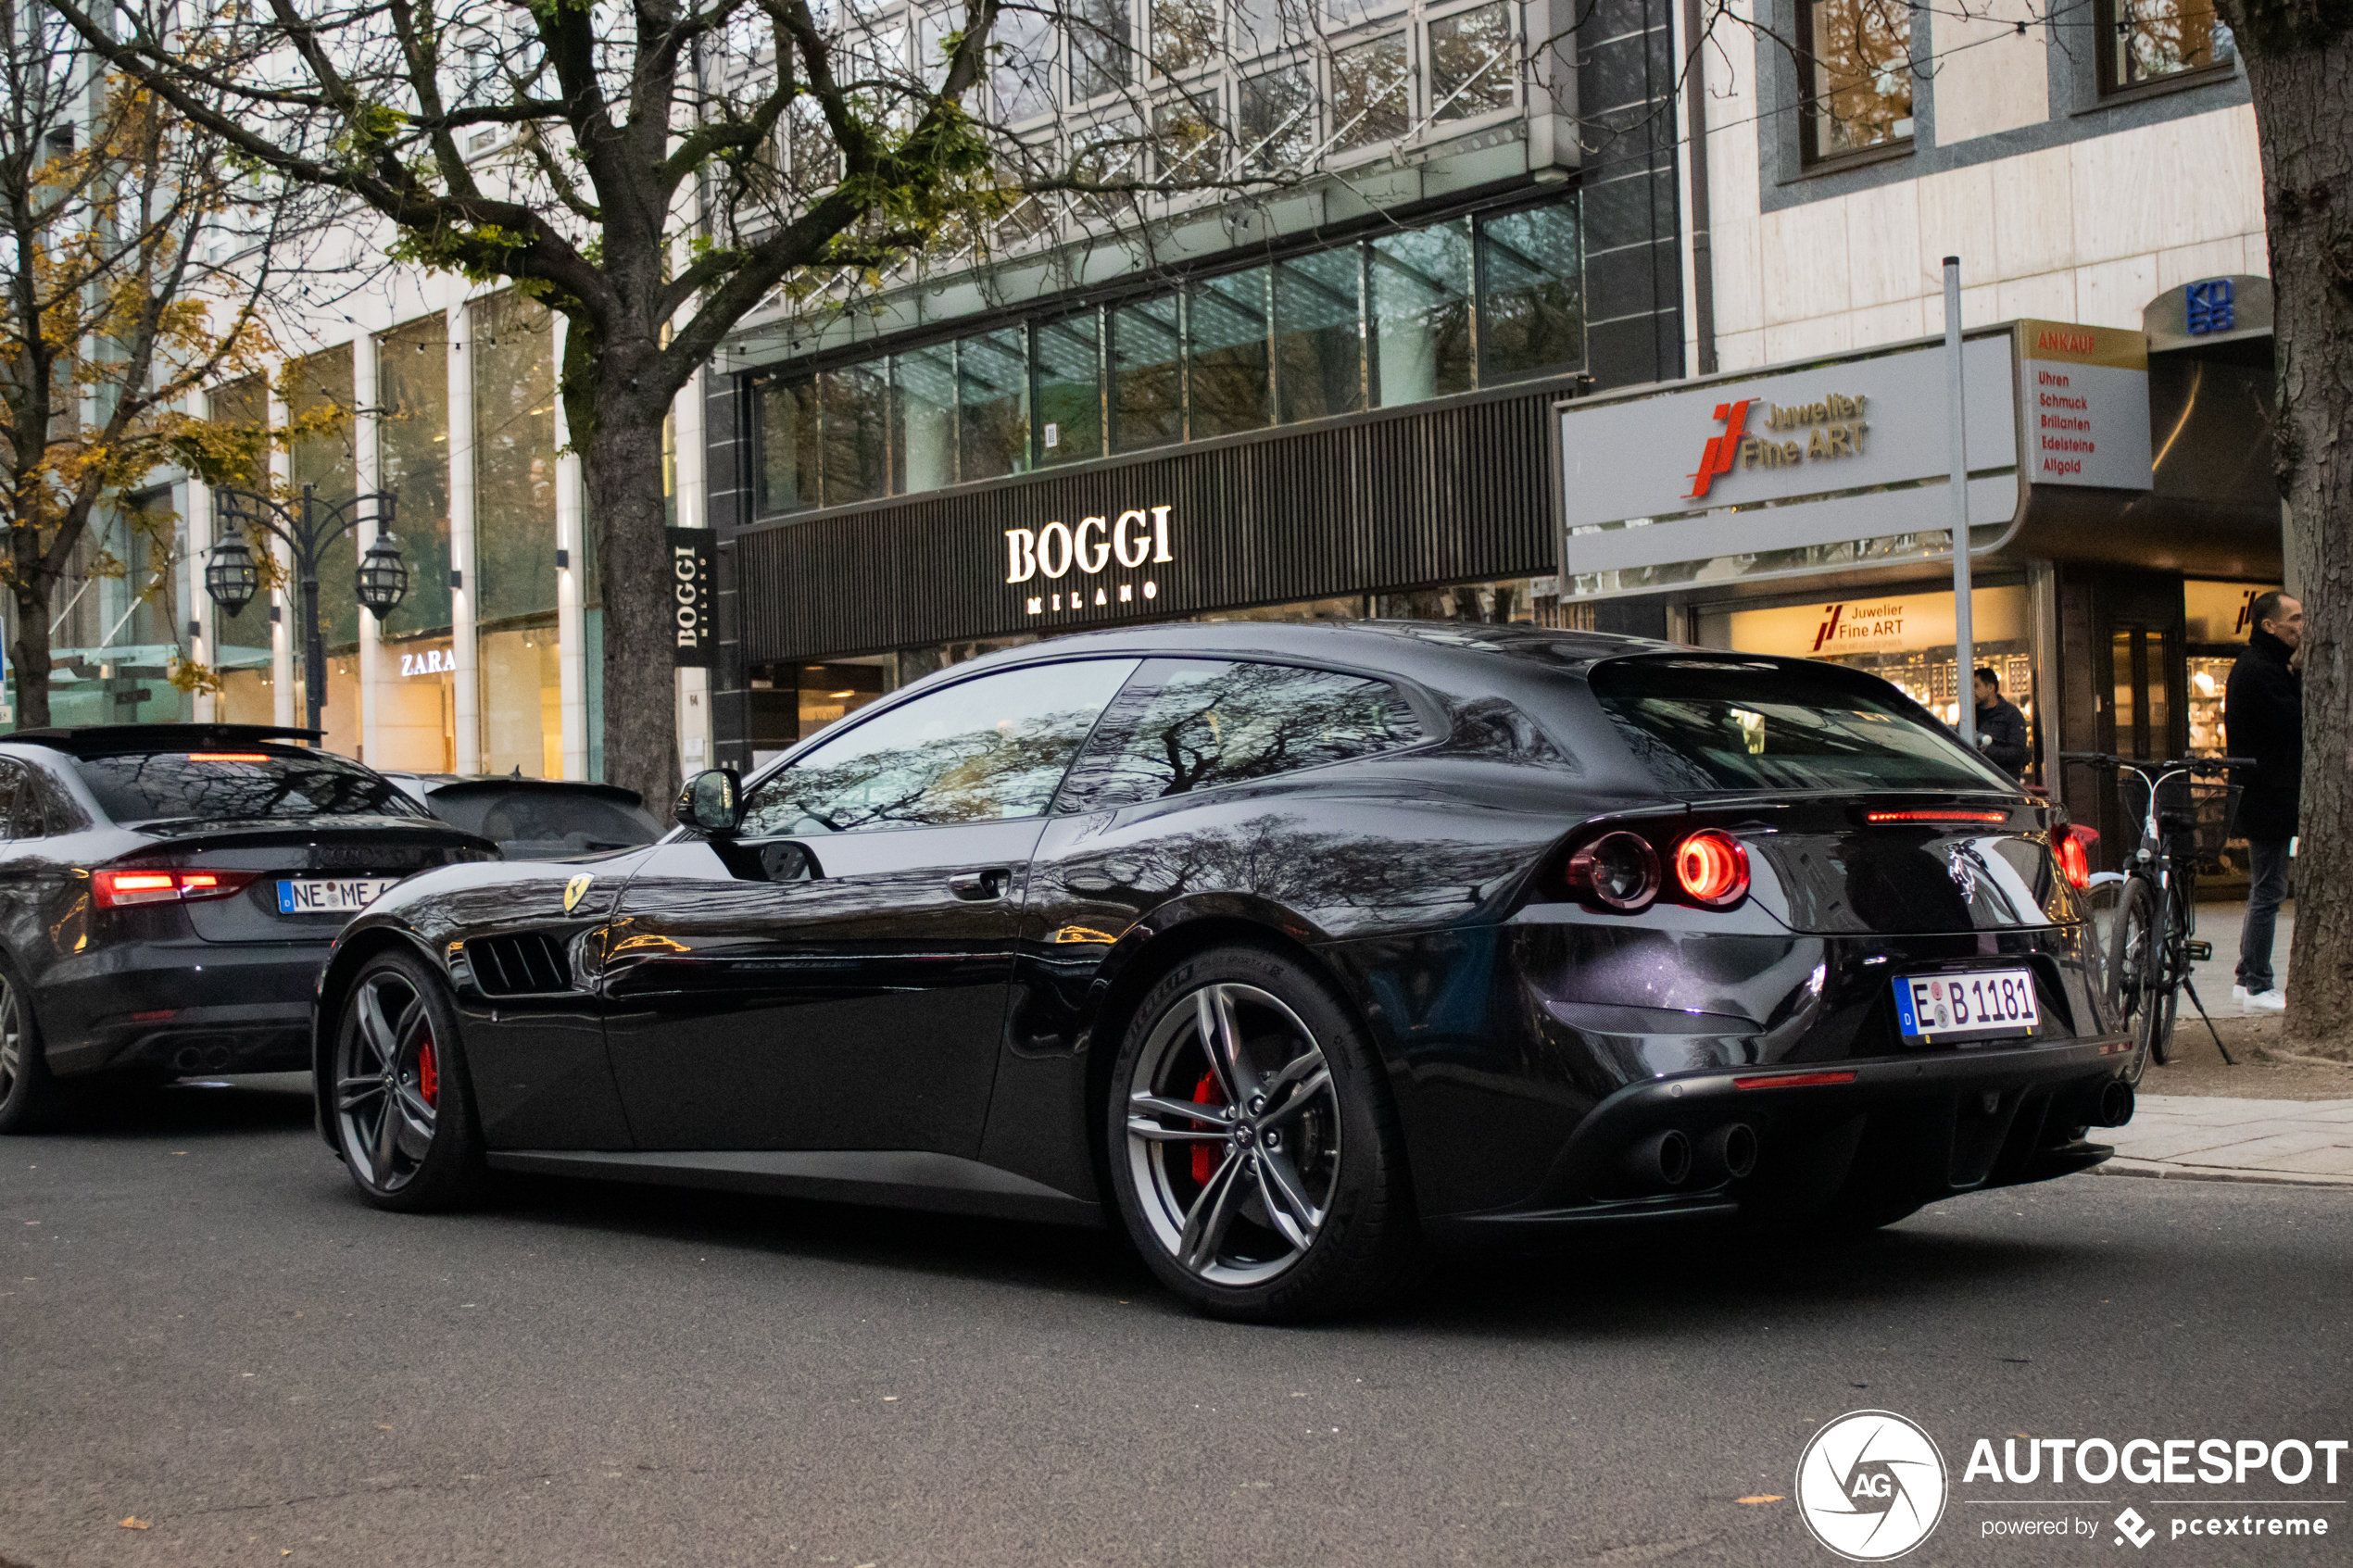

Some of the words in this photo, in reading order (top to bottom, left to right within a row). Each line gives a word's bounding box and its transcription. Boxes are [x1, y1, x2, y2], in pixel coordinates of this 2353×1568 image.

[2038, 331, 2095, 354] ANKAUF
[2038, 371, 2070, 387] Uhren
[1764, 393, 1866, 430] Juwelier
[2039, 393, 2088, 410] Schmuck
[2041, 414, 2091, 432] Brillanten
[1741, 436, 1800, 469] Fine
[1806, 420, 1868, 460] ART
[2041, 435, 2095, 453] Edelsteine
[2043, 458, 2082, 476] Altgold
[1005, 505, 1173, 583] BOGGI
[674, 546, 698, 648] BOGGI
[700, 558, 709, 637] MILANO
[1026, 581, 1157, 615] MILANO
[1851, 603, 1904, 620] Juwelier
[1839, 623, 1869, 639] Fine
[1873, 620, 1904, 636] ART
[400, 648, 457, 677] ZARA
[293, 884, 326, 908] NE
[340, 883, 370, 906] ME
[1912, 984, 1936, 1028] E
[1948, 982, 1969, 1025] B
[1972, 978, 2034, 1022] 1181
[1904, 1012, 1912, 1025] D
